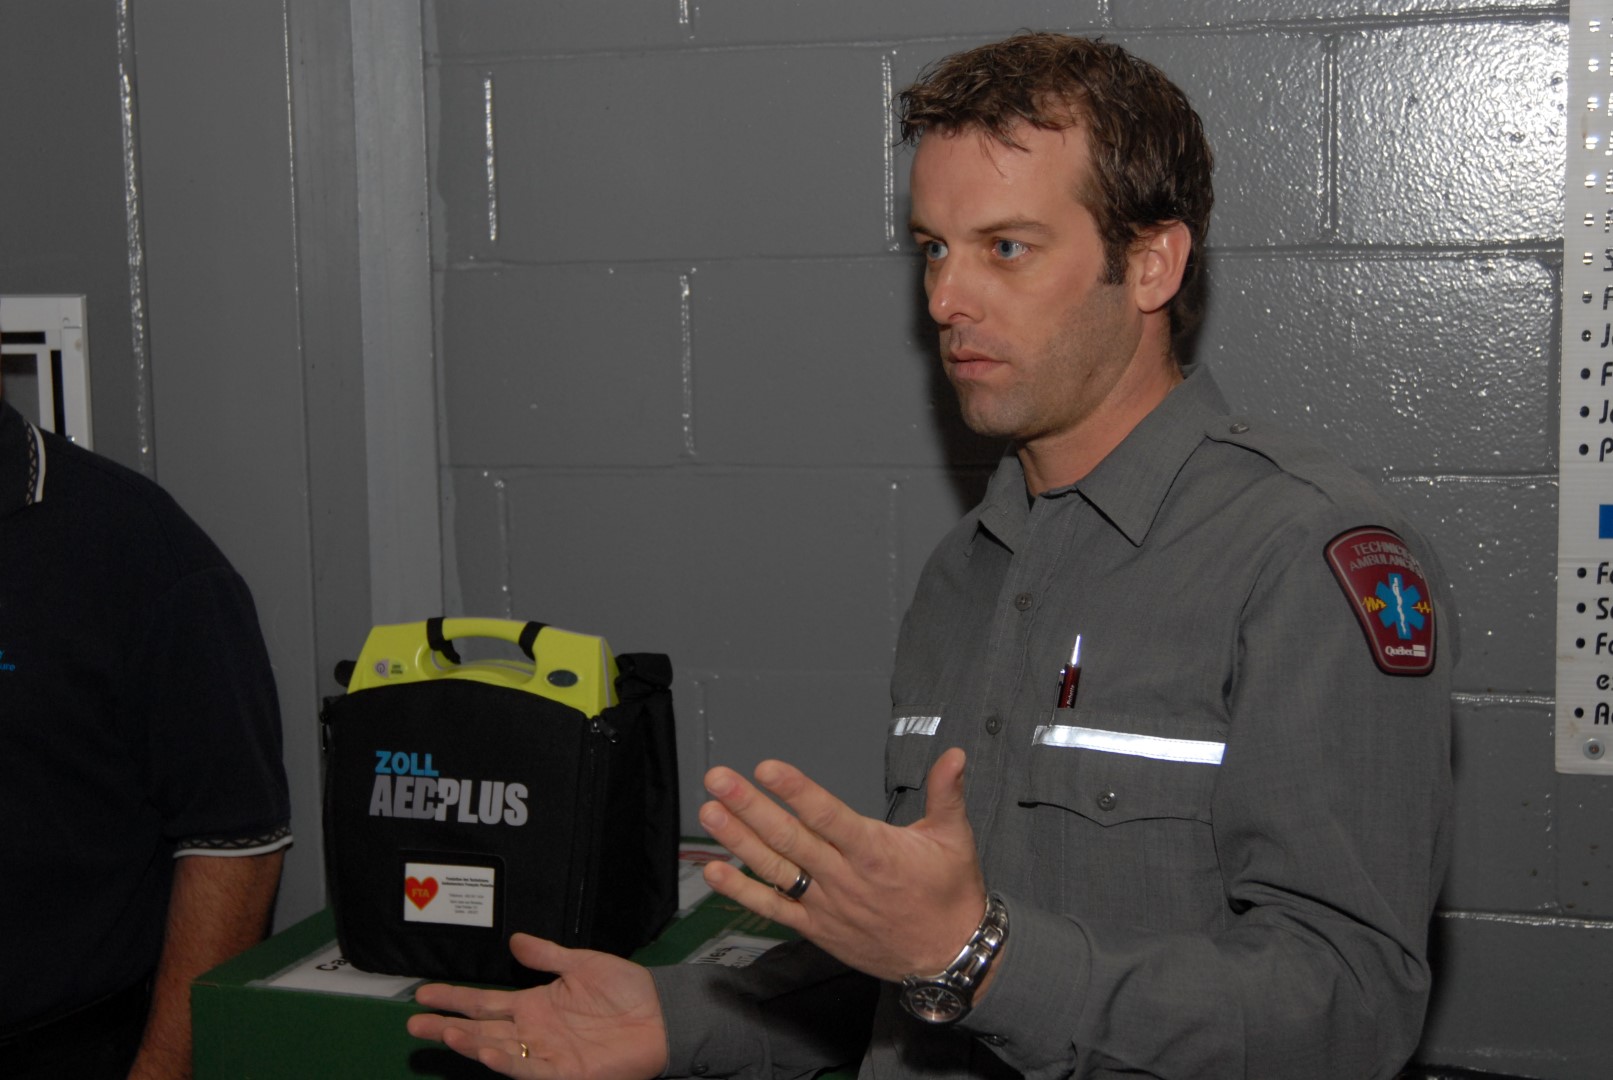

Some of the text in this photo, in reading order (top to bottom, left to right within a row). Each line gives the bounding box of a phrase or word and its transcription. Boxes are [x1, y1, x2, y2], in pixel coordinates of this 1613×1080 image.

[1600, 322, 1613, 349] J
[374, 750, 440, 777] ZOLL
[411, 887, 430, 898] FTA
